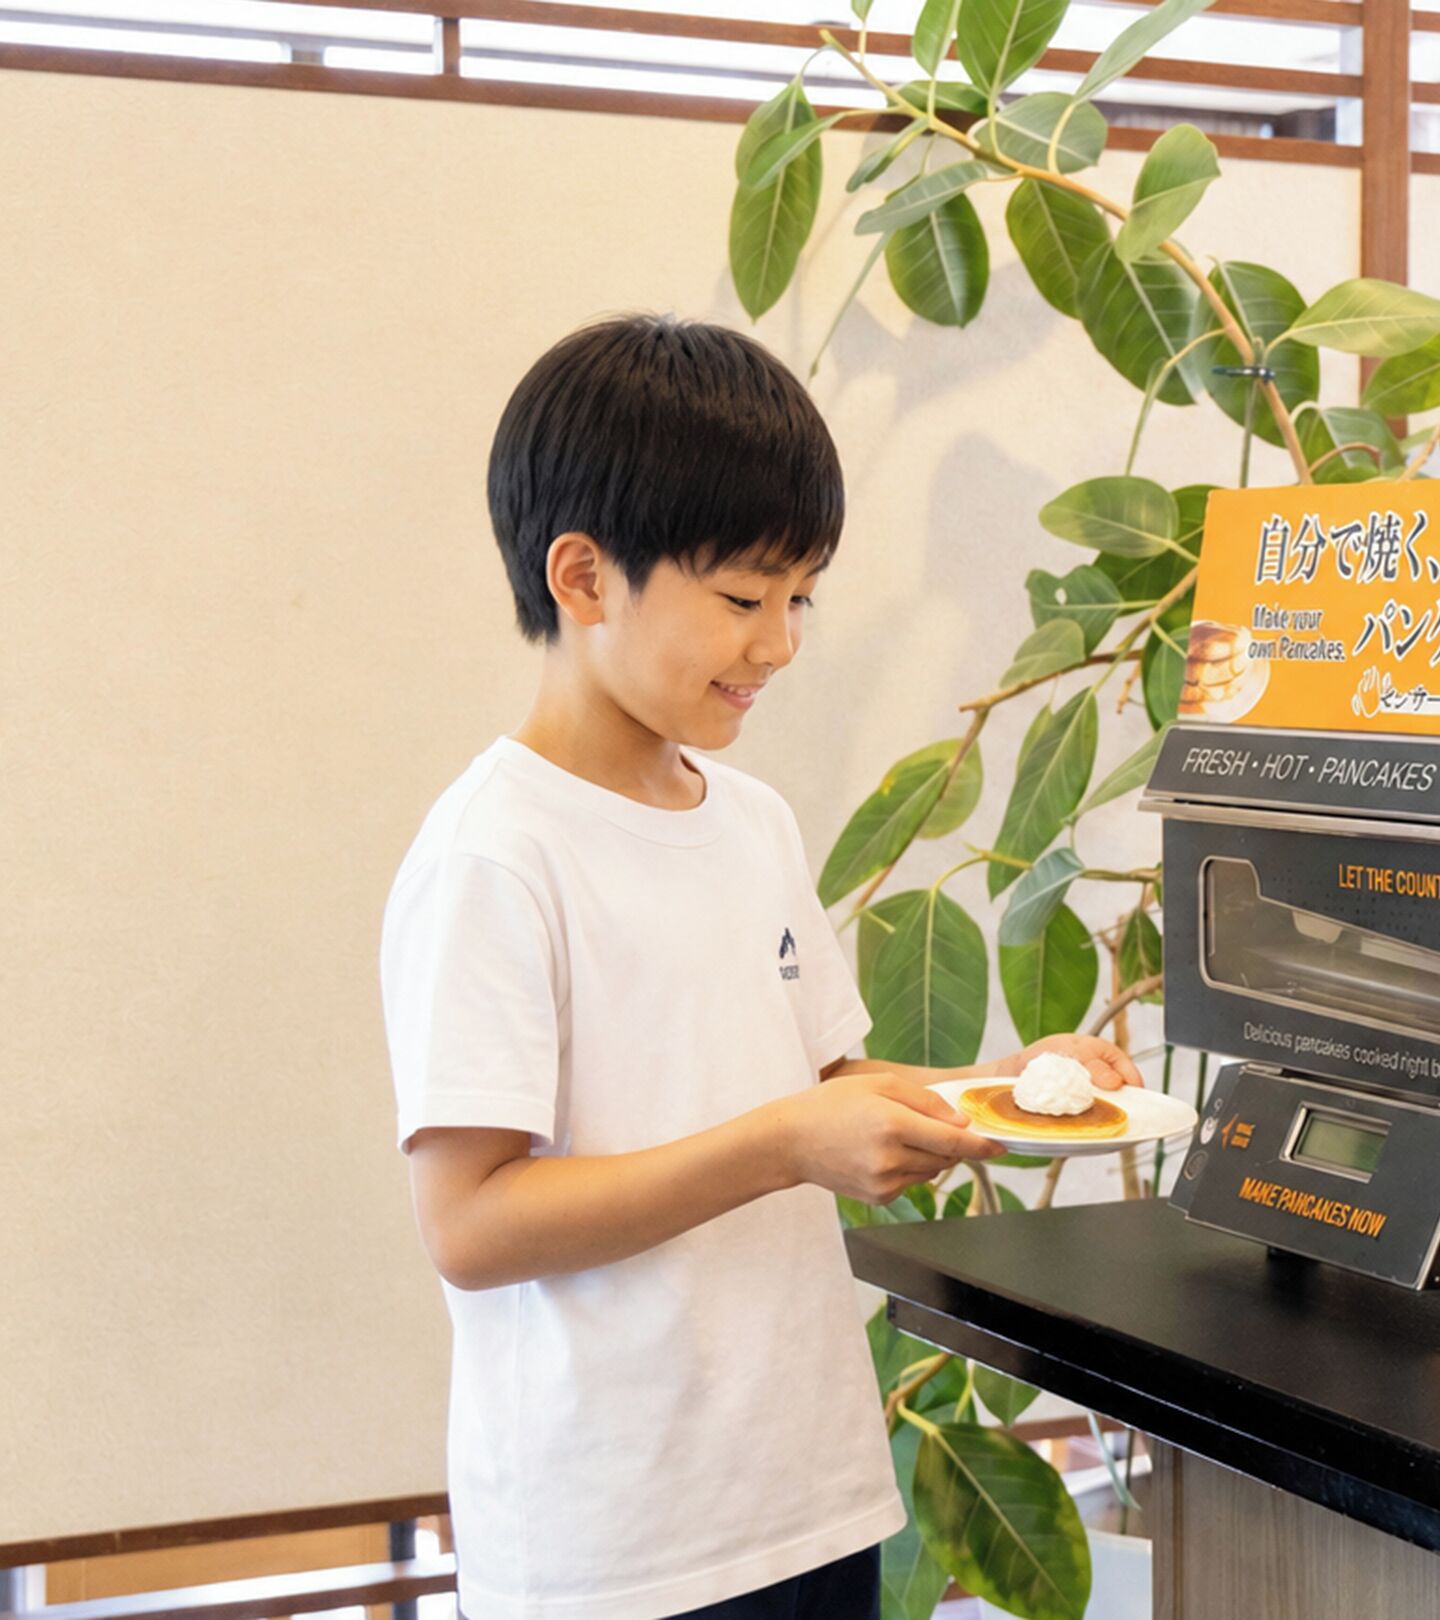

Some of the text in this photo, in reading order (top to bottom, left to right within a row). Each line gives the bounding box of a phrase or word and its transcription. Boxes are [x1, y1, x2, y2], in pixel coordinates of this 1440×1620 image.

[1181, 747, 1437, 791] FRESH HOT PANCAKES
[1338, 863, 1364, 889] LET
[1366, 867, 1393, 893] THE
[1401, 1051, 1429, 1079] right
[1239, 1177, 1387, 1238] MAKE PANCAKES NOW
